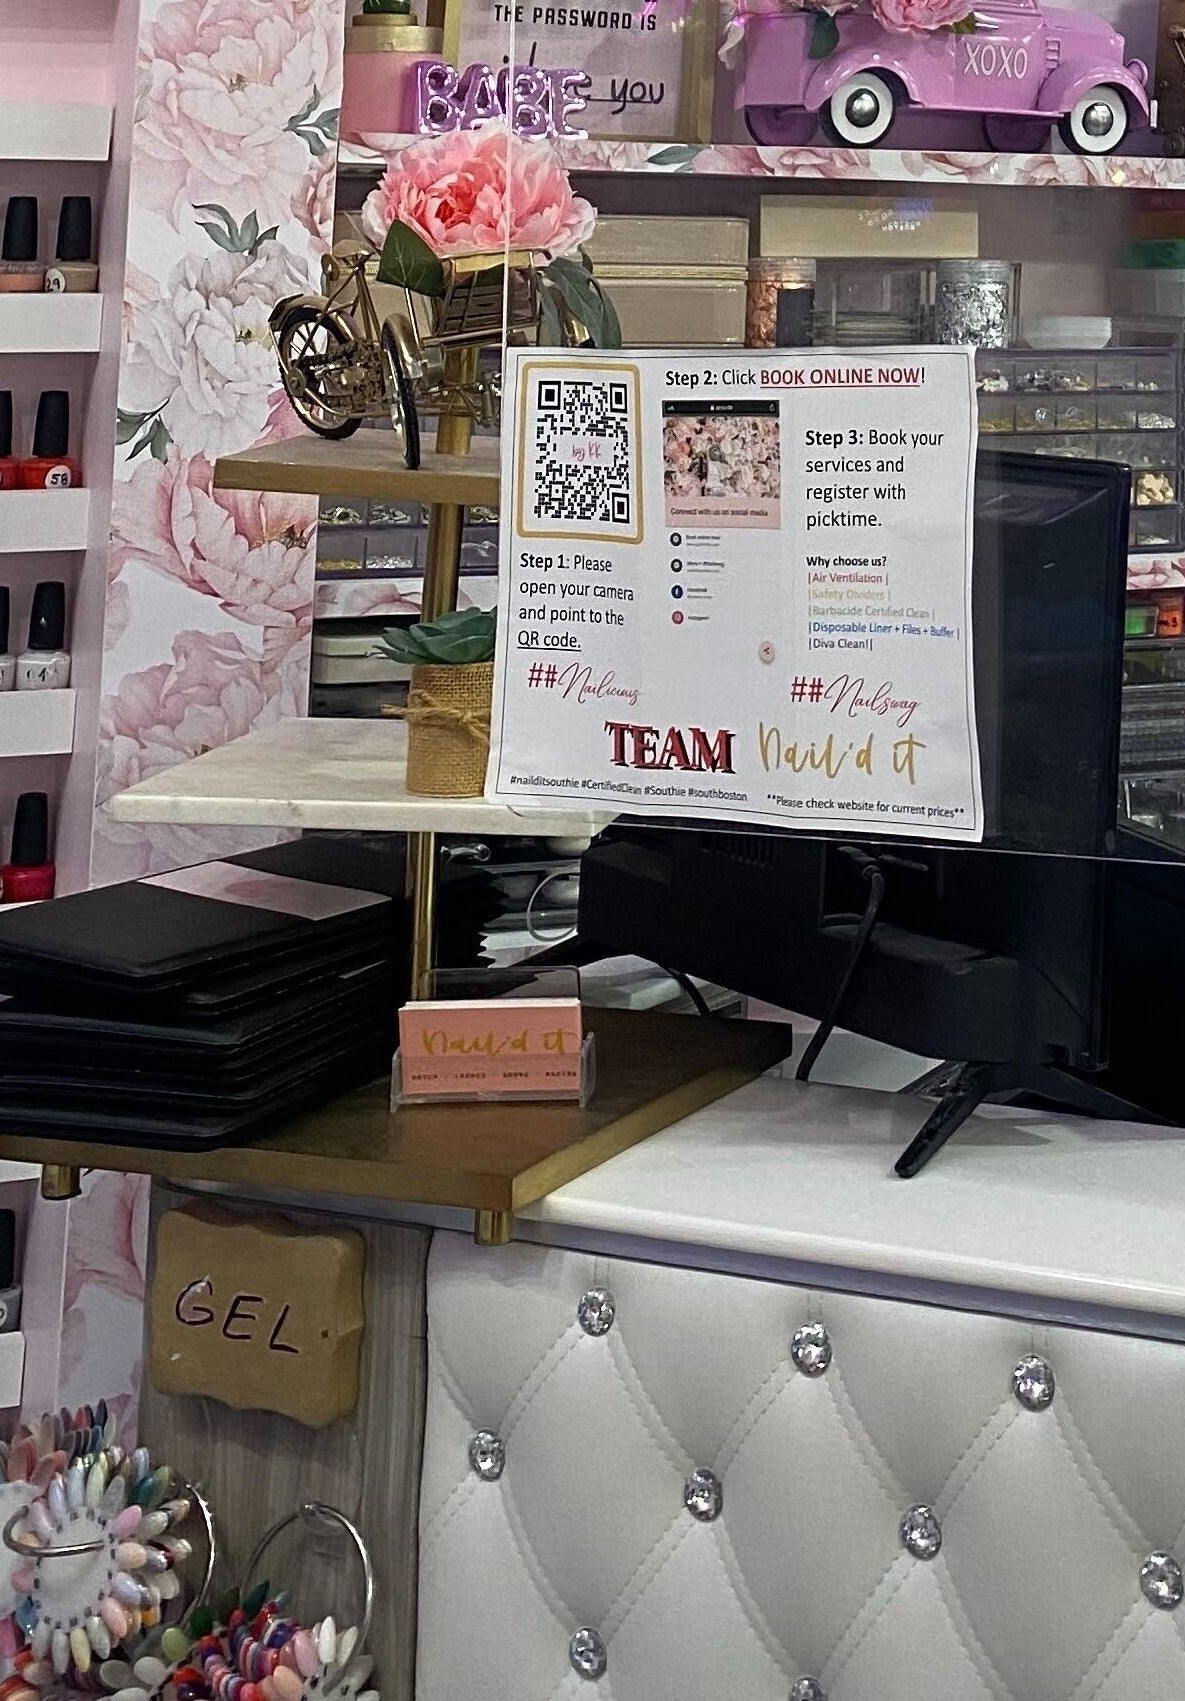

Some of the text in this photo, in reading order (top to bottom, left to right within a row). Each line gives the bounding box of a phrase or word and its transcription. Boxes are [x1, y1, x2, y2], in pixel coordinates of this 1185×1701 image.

[494, 4, 657, 31] THE PASSWORD IS
[963, 41, 1028, 80] XOXO
[410, 60, 593, 140] BABE
[610, 77, 665, 115] you
[666, 367, 925, 388] Step 2: Click BOOK ONLINE NOW!
[805, 428, 944, 449] Step 3: Book your
[805, 456, 904, 472] services and
[50, 473, 68, 486] 58
[806, 483, 906, 503] register with
[806, 510, 882, 530] picktime.
[520, 553, 612, 572] Step 1: Please
[806, 556, 887, 568] Why choose us?
[830, 573, 883, 583] Ventilation
[520, 582, 634, 601] open your camera
[519, 604, 624, 626] and point to the
[865, 605, 904, 618] Certified
[906, 608, 930, 618] Clean
[517, 630, 581, 650] QR code.
[869, 624, 893, 634] Liner
[902, 624, 921, 635] Files
[930, 626, 954, 637] Buffer
[603, 720, 737, 775] TEAM
[892, 733, 927, 785] it
[581, 779, 642, 796] #CertifiedClean
[644, 785, 686, 797] #Southie
[688, 786, 748, 801] #southboston
[806, 797, 835, 810] check
[837, 798, 874, 811] website
[876, 800, 890, 813] for
[892, 803, 925, 816] current
[174, 1278, 300, 1354] GEL
